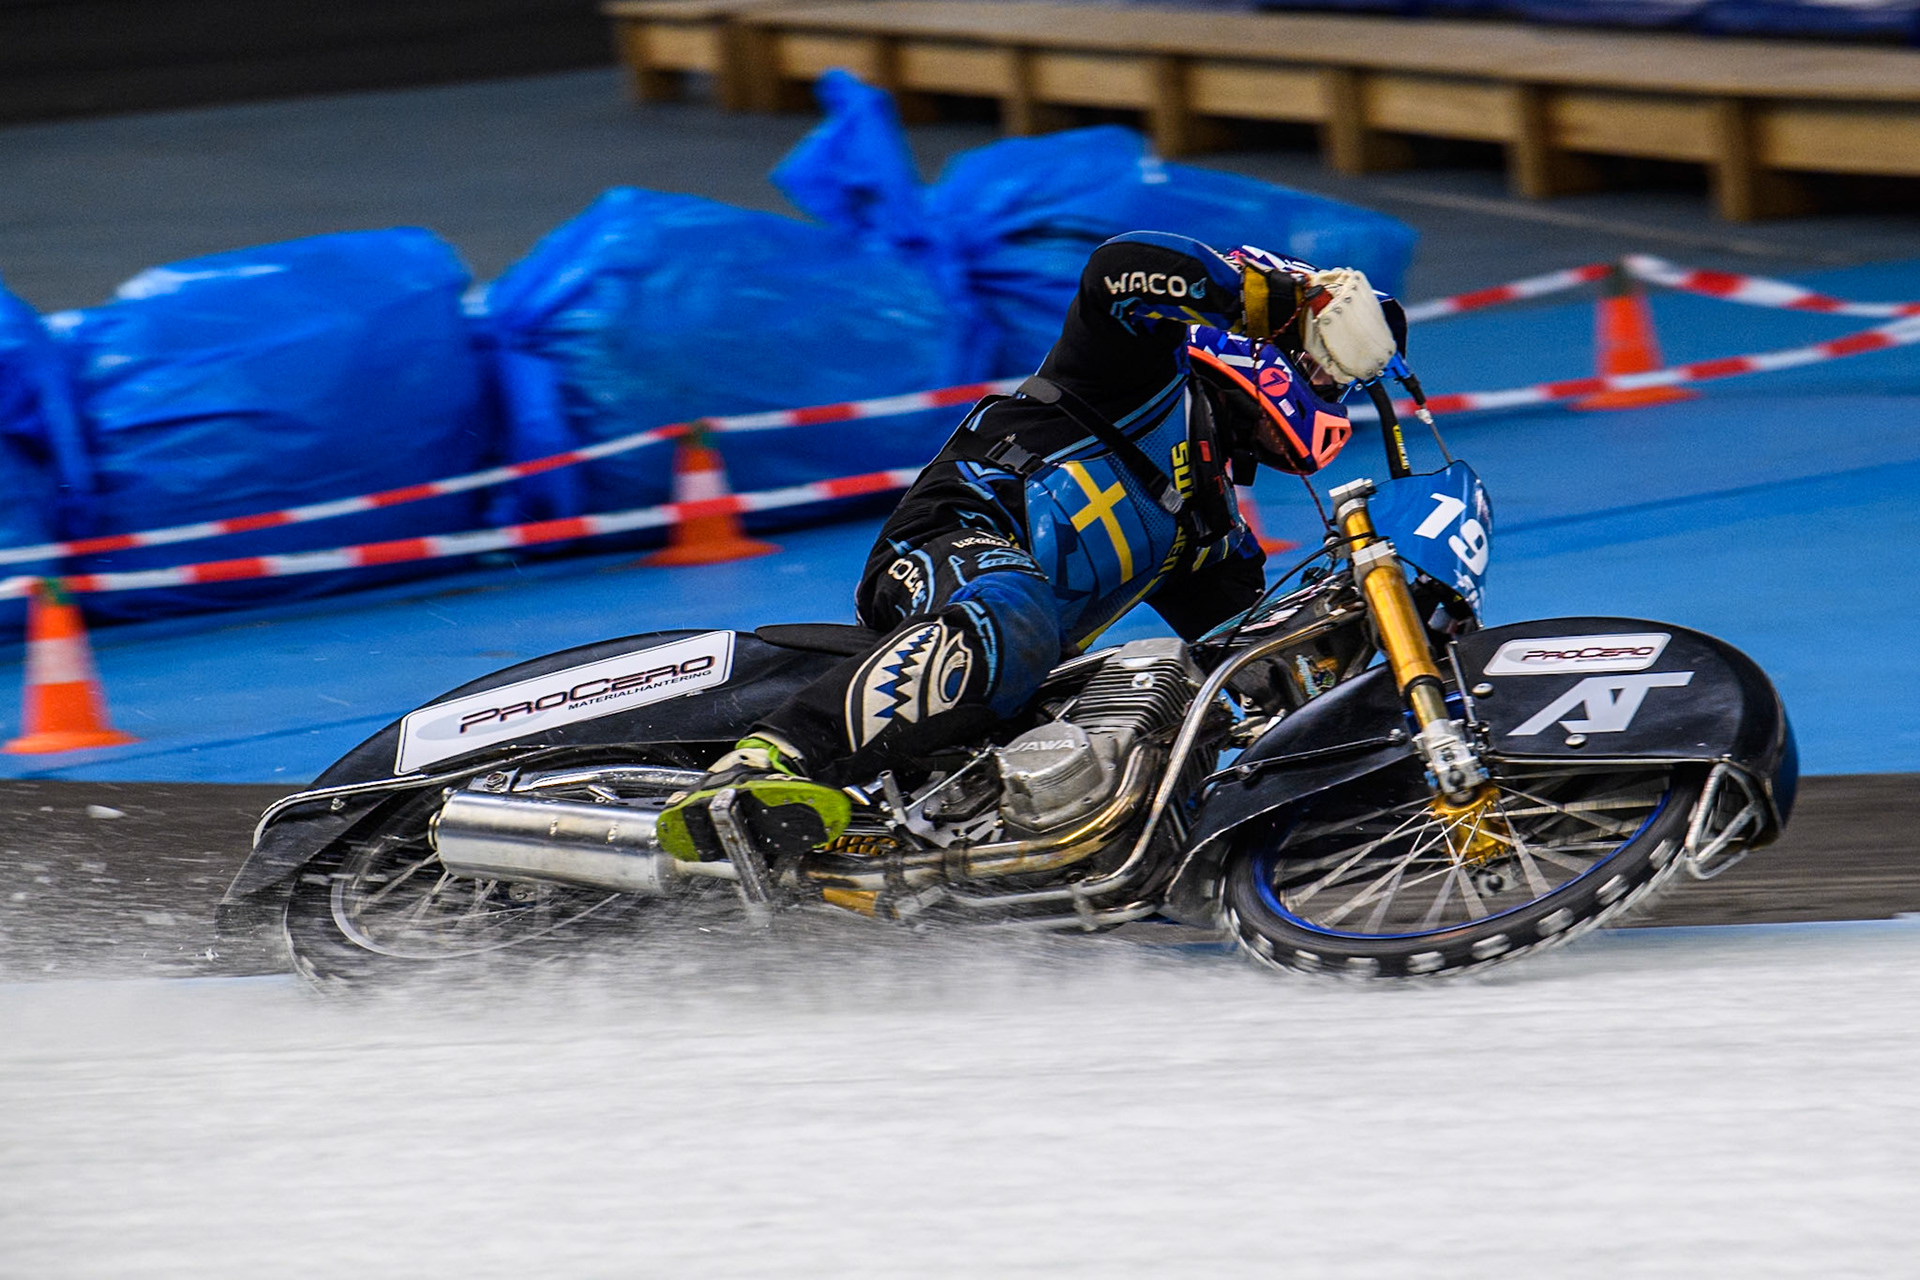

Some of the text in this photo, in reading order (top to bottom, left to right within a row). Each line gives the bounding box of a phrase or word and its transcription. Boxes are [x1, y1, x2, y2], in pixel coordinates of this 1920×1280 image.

[1104, 271, 1188, 298] WACO
[1158, 440, 1194, 575] SWEN
[1413, 492, 1490, 577] 19
[1521, 646, 1656, 662] PROCERO
[459, 655, 717, 734] PROCERO
[568, 670, 712, 711] MATERIALHANTERING
[1006, 739, 1076, 753] JAWA
